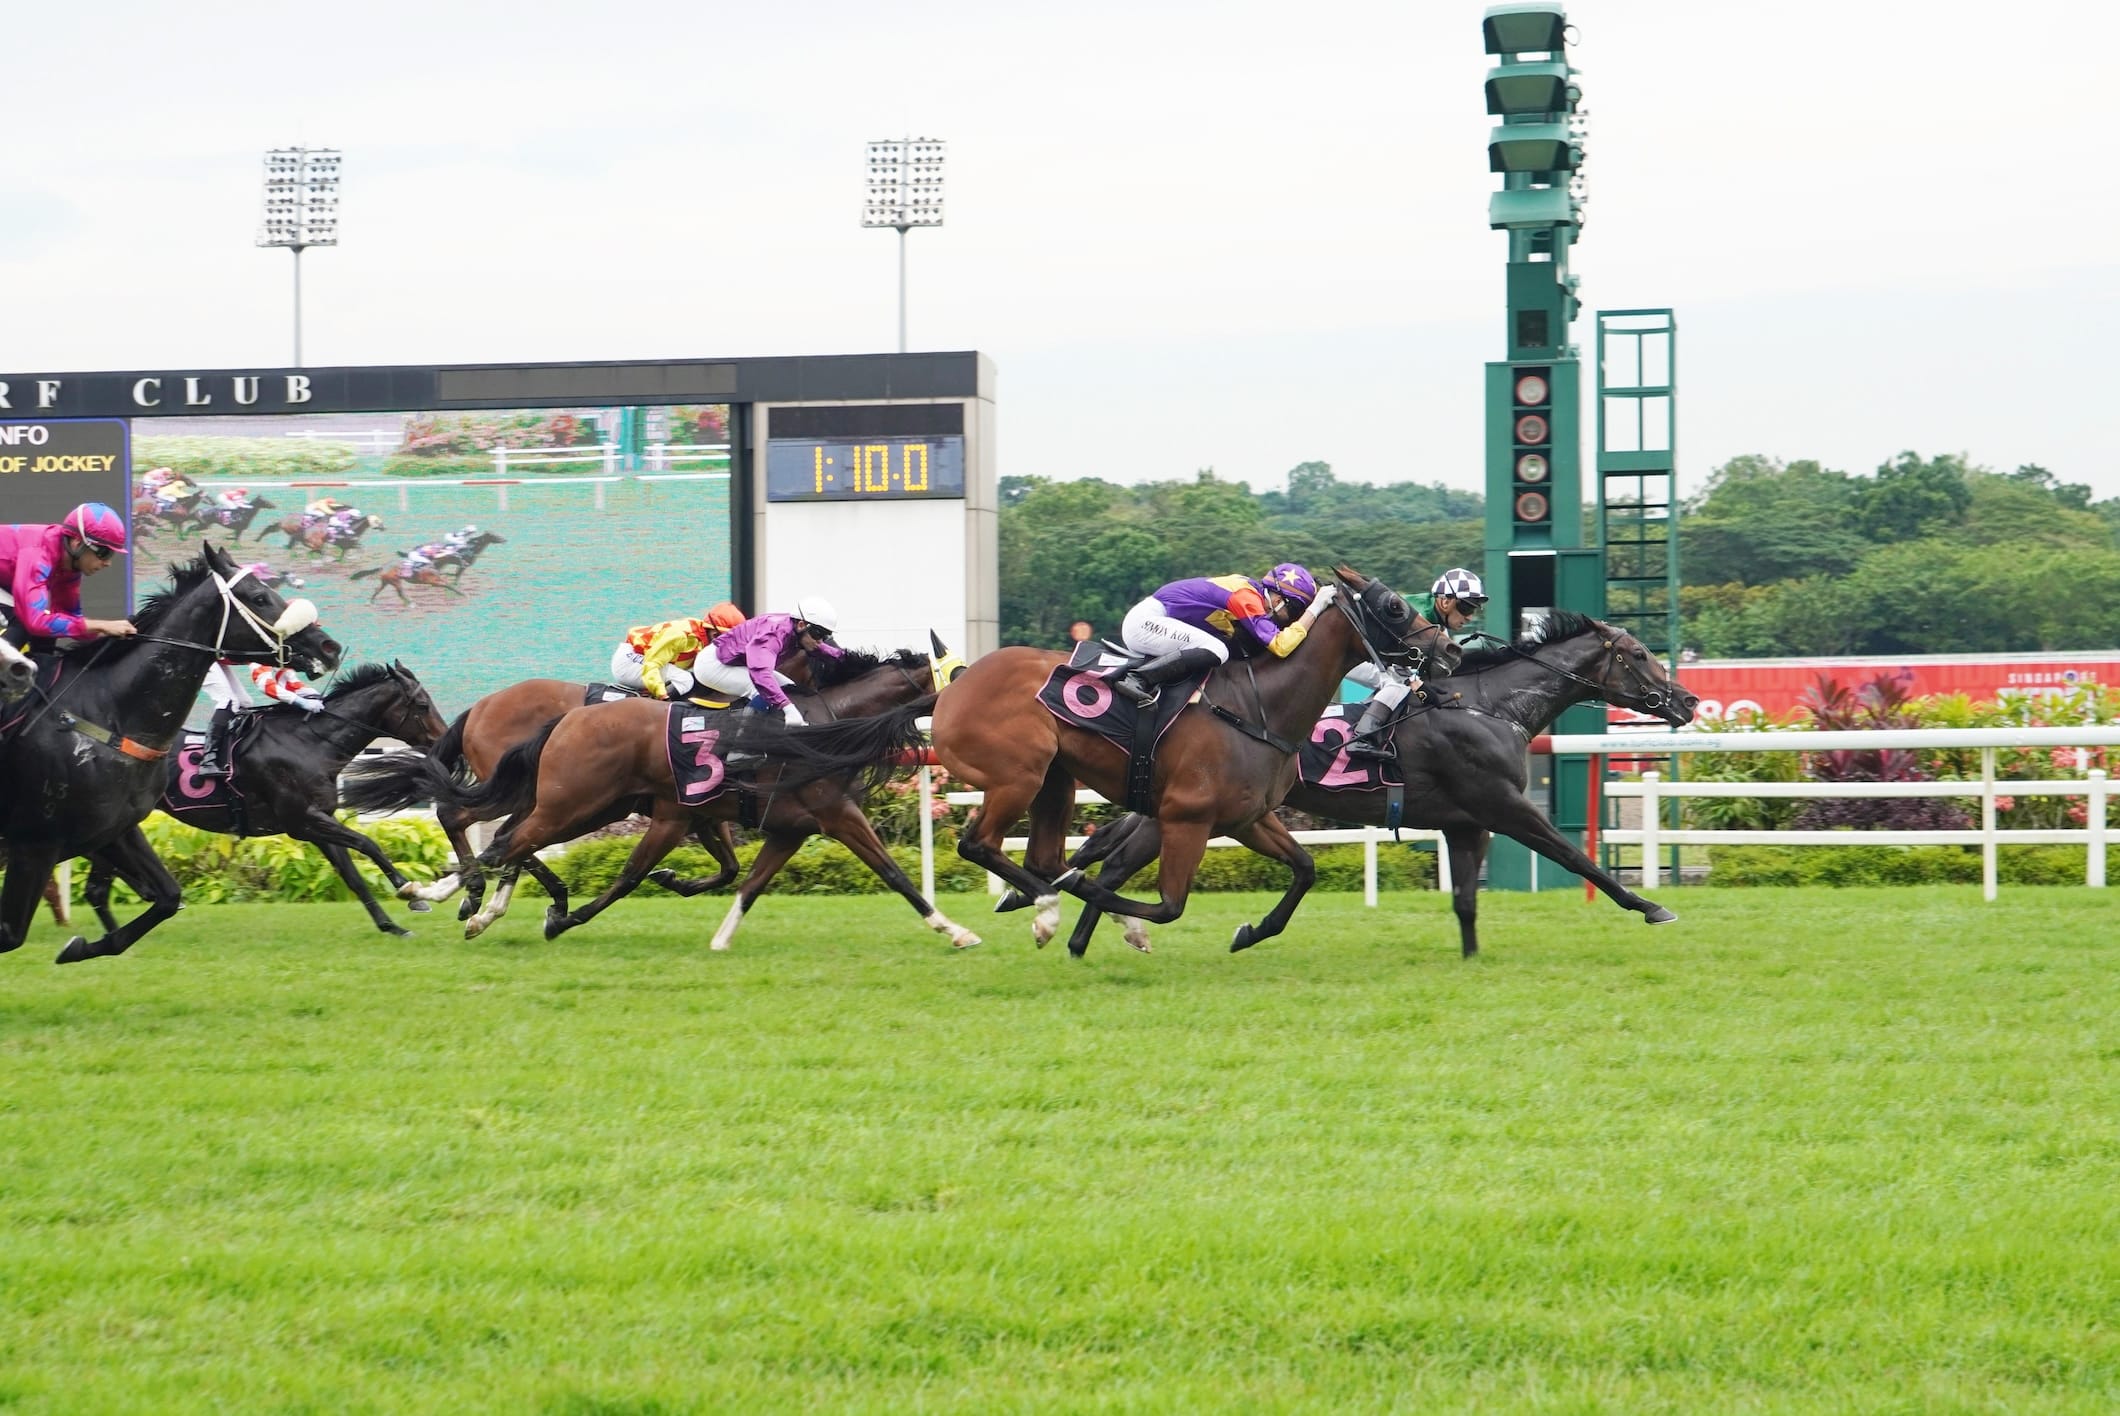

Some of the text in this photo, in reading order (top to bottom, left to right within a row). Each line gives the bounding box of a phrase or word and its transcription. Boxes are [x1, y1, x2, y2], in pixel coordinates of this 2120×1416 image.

[132, 374, 313, 407] CLUB
[0, 455, 117, 473] OF JOCKEY
[815, 444, 928, 493] 1:10.0
[1141, 620, 1191, 643] SIMON KOK
[177, 744, 216, 799] 8
[681, 729, 724, 796] 3
[1311, 718, 1369, 786] 2
